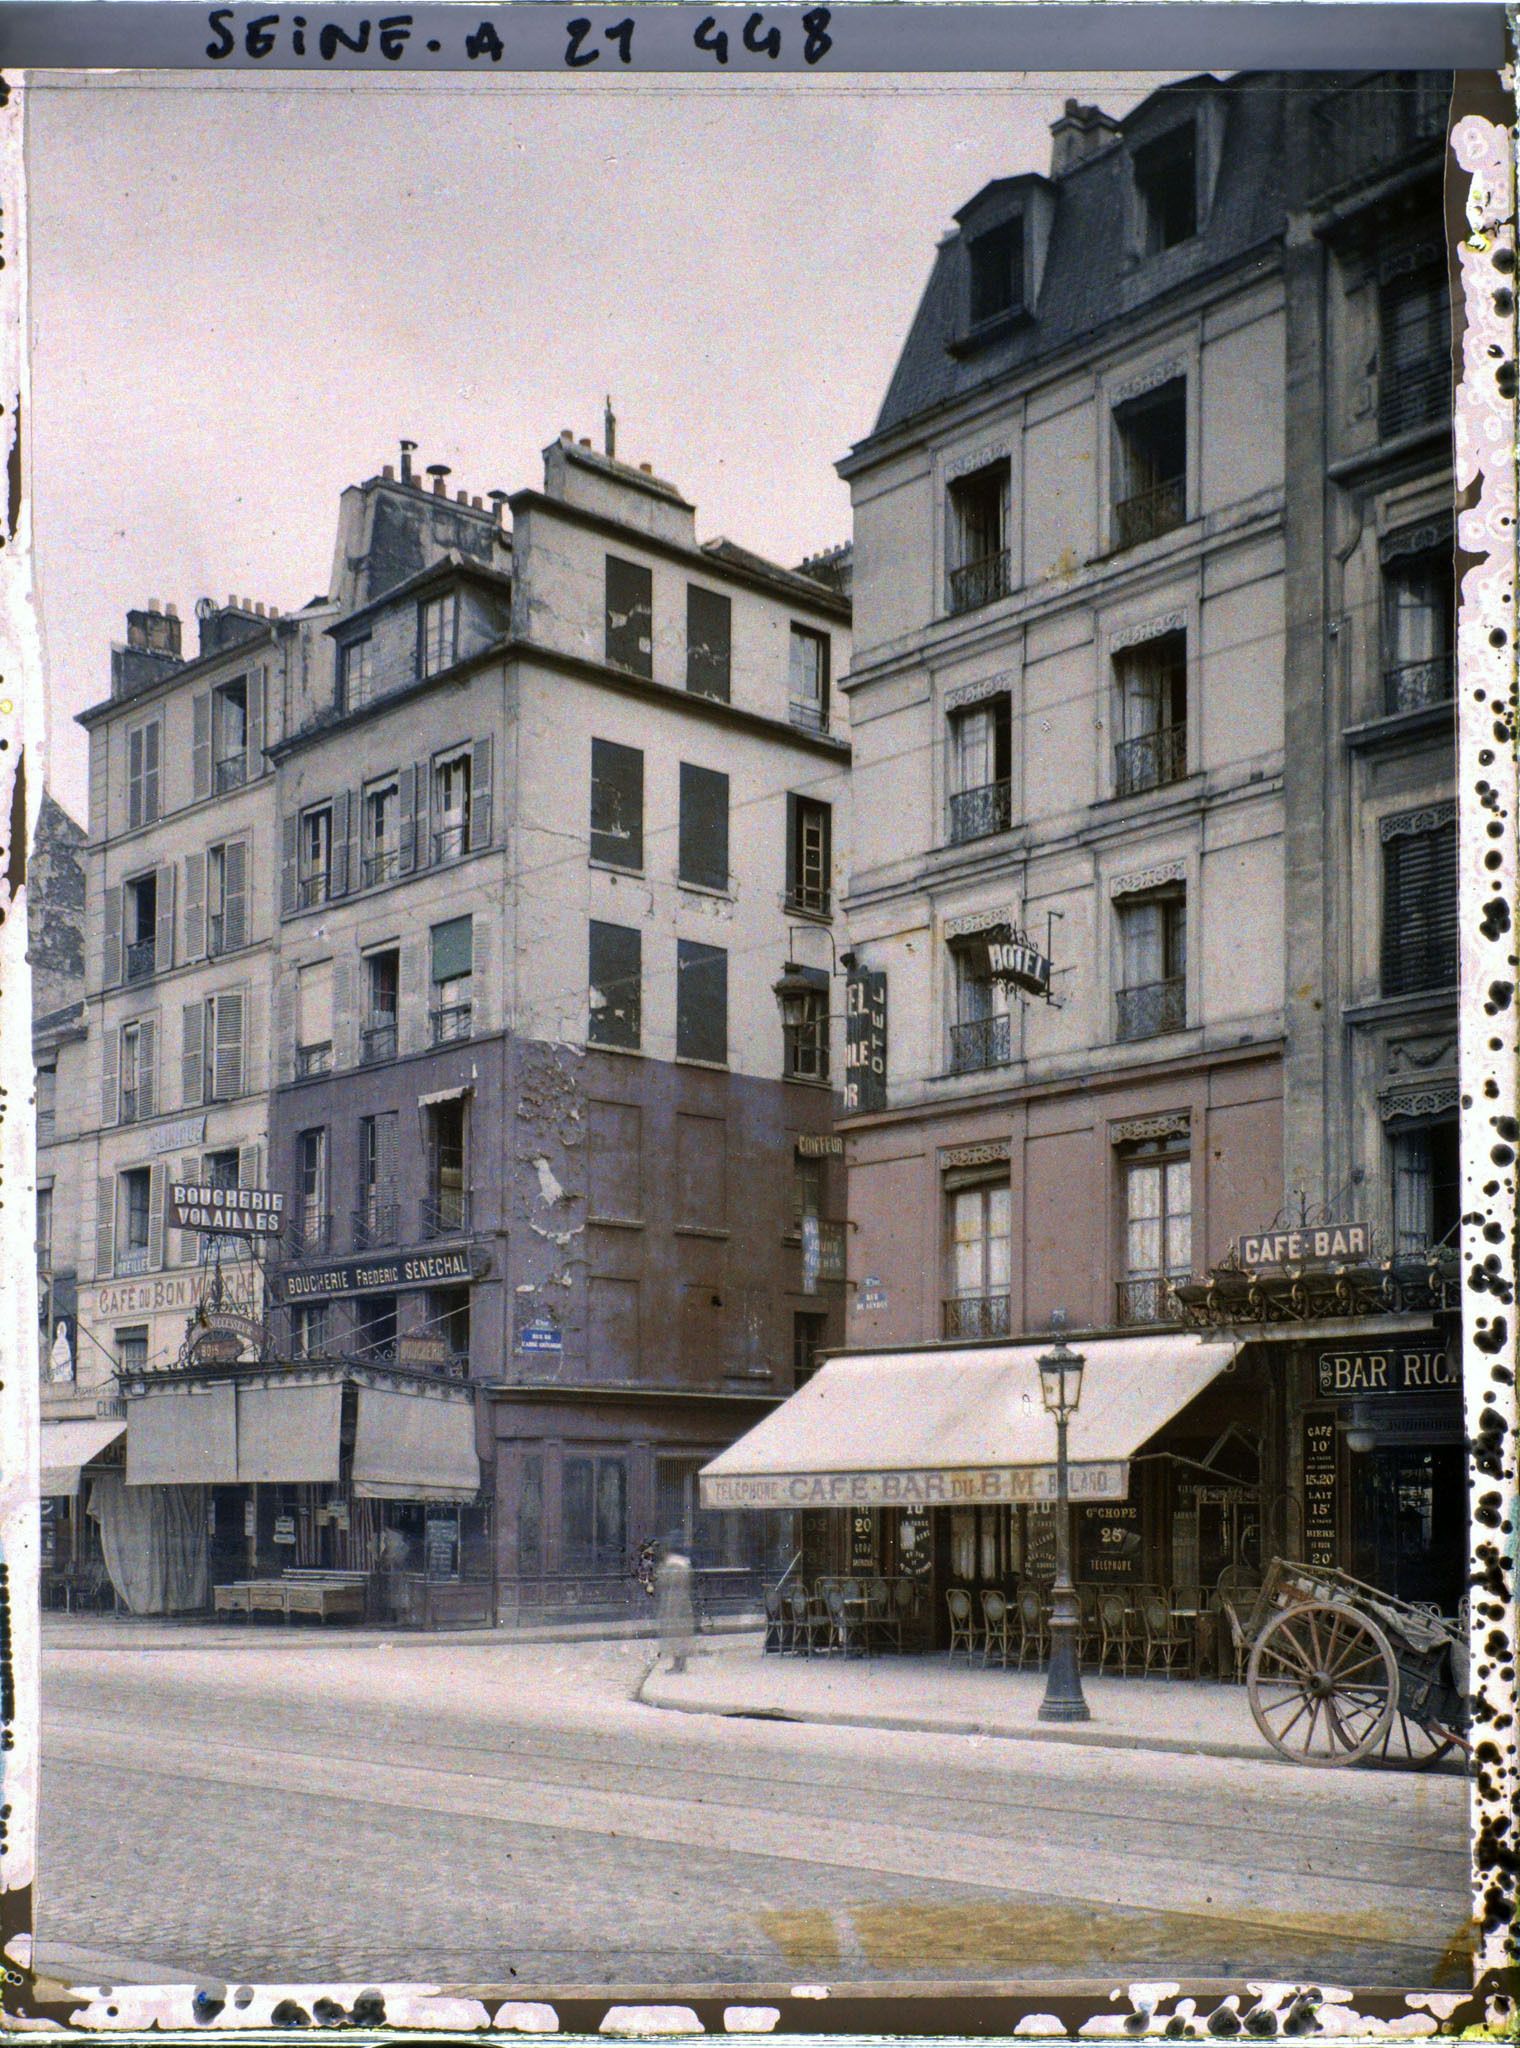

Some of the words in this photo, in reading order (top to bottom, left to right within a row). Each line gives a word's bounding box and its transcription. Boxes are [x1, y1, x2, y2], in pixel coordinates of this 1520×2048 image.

[564, 18, 634, 66] 21
[693, 7, 833, 64] 448
[174, 1186, 283, 1212] BOUCHERIE
[177, 1206, 279, 1231] VOLAILLES
[1245, 1231, 1301, 1264] CAFÉ
[1315, 1227, 1364, 1257] BAR
[288, 1271, 349, 1294] BOUCHERIE
[405, 1255, 467, 1280] SÉNÉCHAL
[1334, 1356, 1387, 1389] BAR
[855, 1518, 871, 1532] 20
[1098, 1507, 1137, 1518] CHOPE
[1101, 1527, 1122, 1542] 25
